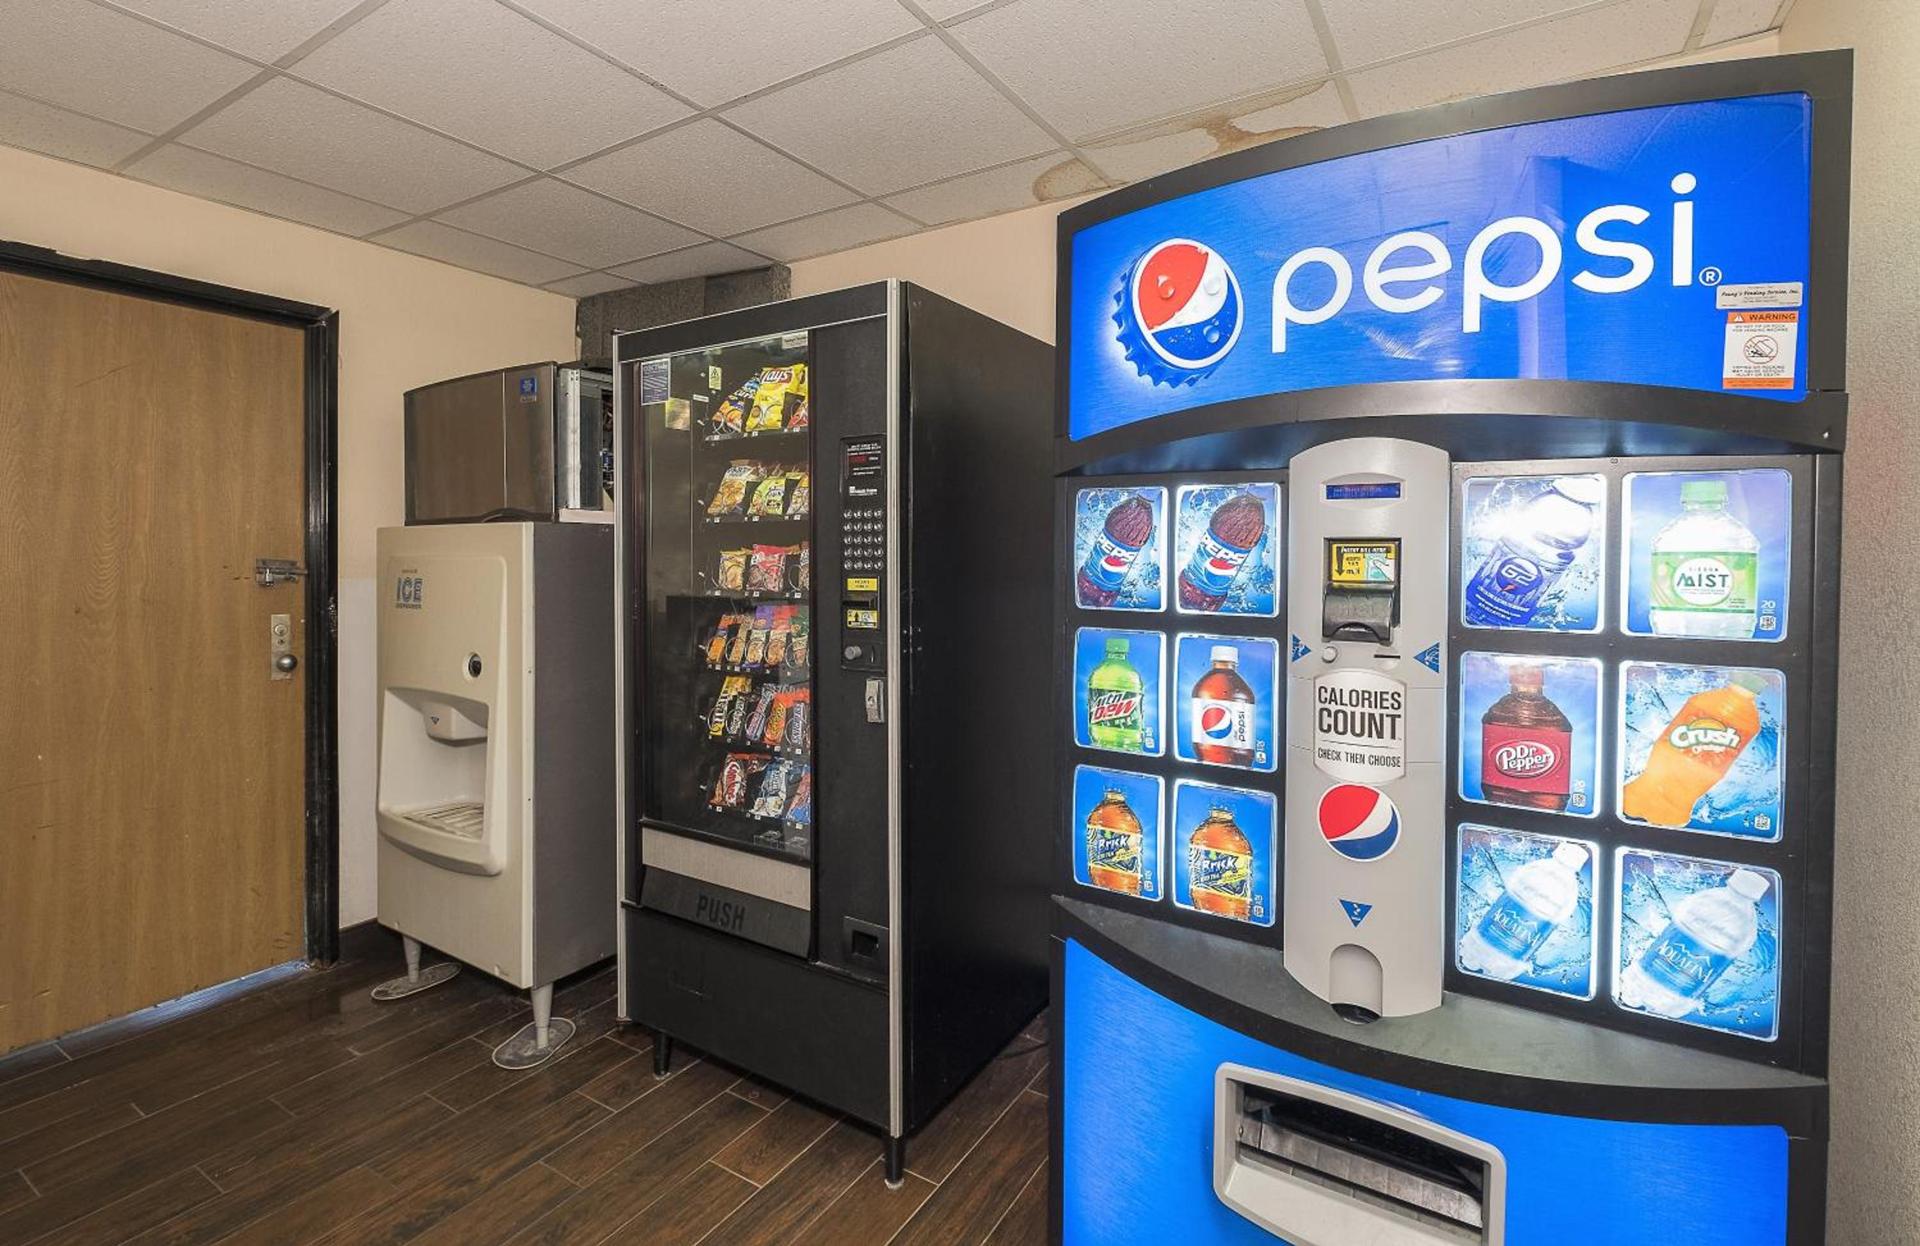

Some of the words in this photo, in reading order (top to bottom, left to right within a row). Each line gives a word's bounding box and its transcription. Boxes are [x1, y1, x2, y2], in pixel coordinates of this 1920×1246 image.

[1271, 172, 1697, 353] pepsi
[1749, 313, 1796, 321] WARNING
[1501, 564, 1537, 586] G2
[1676, 573, 1729, 588] MIST
[396, 576, 423, 603] ICE
[1761, 600, 1776, 609] 20
[1318, 685, 1402, 711] CALORIES
[1318, 707, 1402, 740] COUNT
[1670, 725, 1741, 749] Crush
[1317, 747, 1342, 762] CHECK
[1345, 752, 1366, 765] THEN
[1368, 755, 1401, 768] CHOOSE
[1502, 748, 1551, 771] Pepper
[1517, 745, 1537, 758] Dr
[696, 895, 746, 931] PUSH
